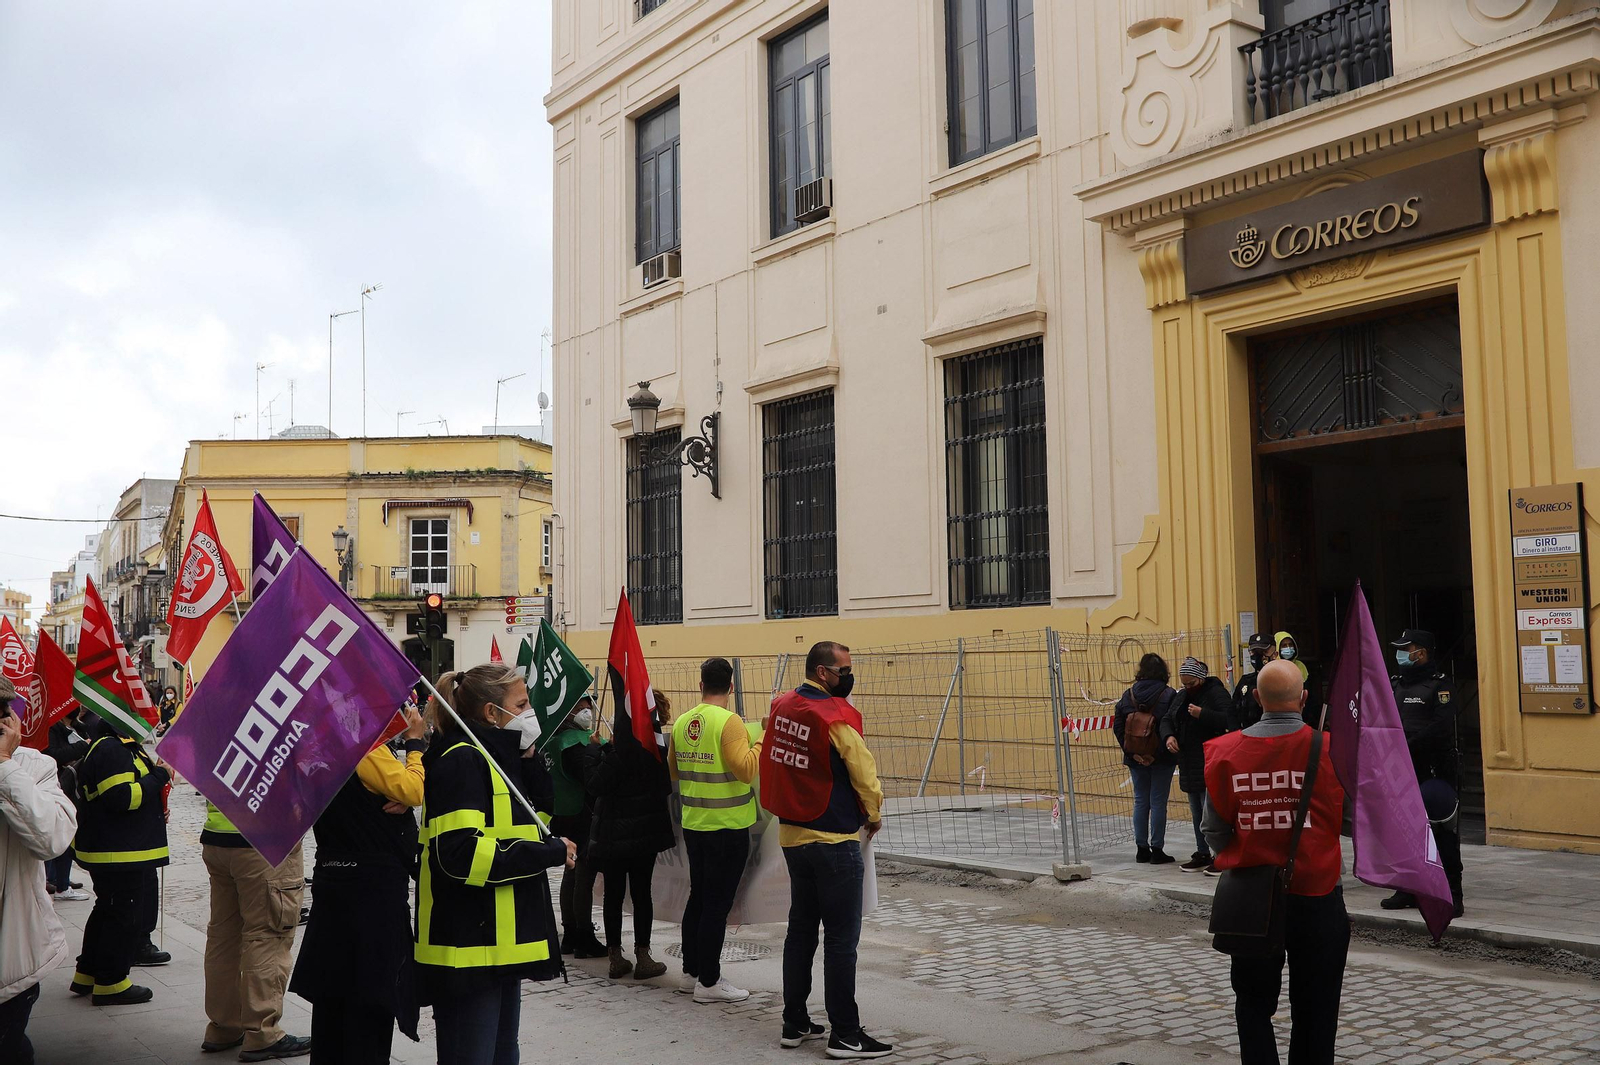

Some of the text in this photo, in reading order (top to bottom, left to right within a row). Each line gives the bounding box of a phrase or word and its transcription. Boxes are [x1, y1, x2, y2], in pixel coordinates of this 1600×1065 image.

[1270, 196, 1422, 260] CORREOS
[1525, 501, 1573, 514] CORREOS
[1536, 538, 1557, 547] GIRO
[1521, 588, 1568, 596] WESTERN
[1528, 616, 1572, 626] Express
[774, 715, 811, 742] CCOO
